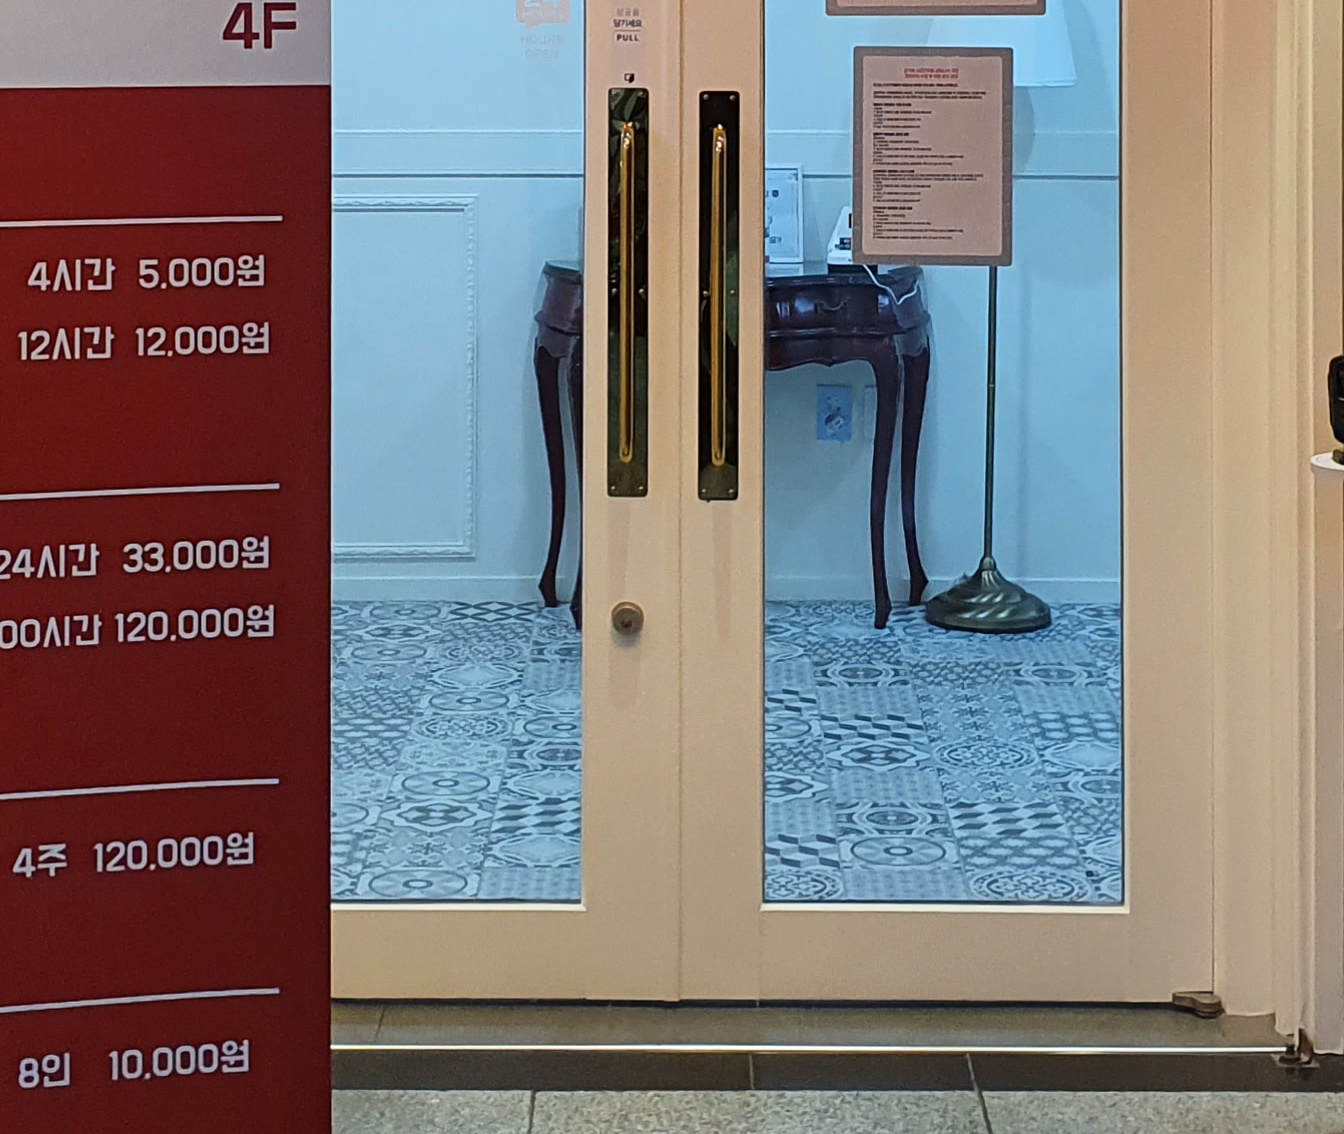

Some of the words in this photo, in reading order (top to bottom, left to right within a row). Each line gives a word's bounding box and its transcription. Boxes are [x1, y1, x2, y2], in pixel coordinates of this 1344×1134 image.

[222, 1, 298, 51] 4F
[616, 34, 639, 42] PULL
[27, 257, 116, 293] 4시간
[17, 326, 115, 362] 12시간
[12, 842, 68, 879] 4주
[17, 1052, 71, 1090] 8인
